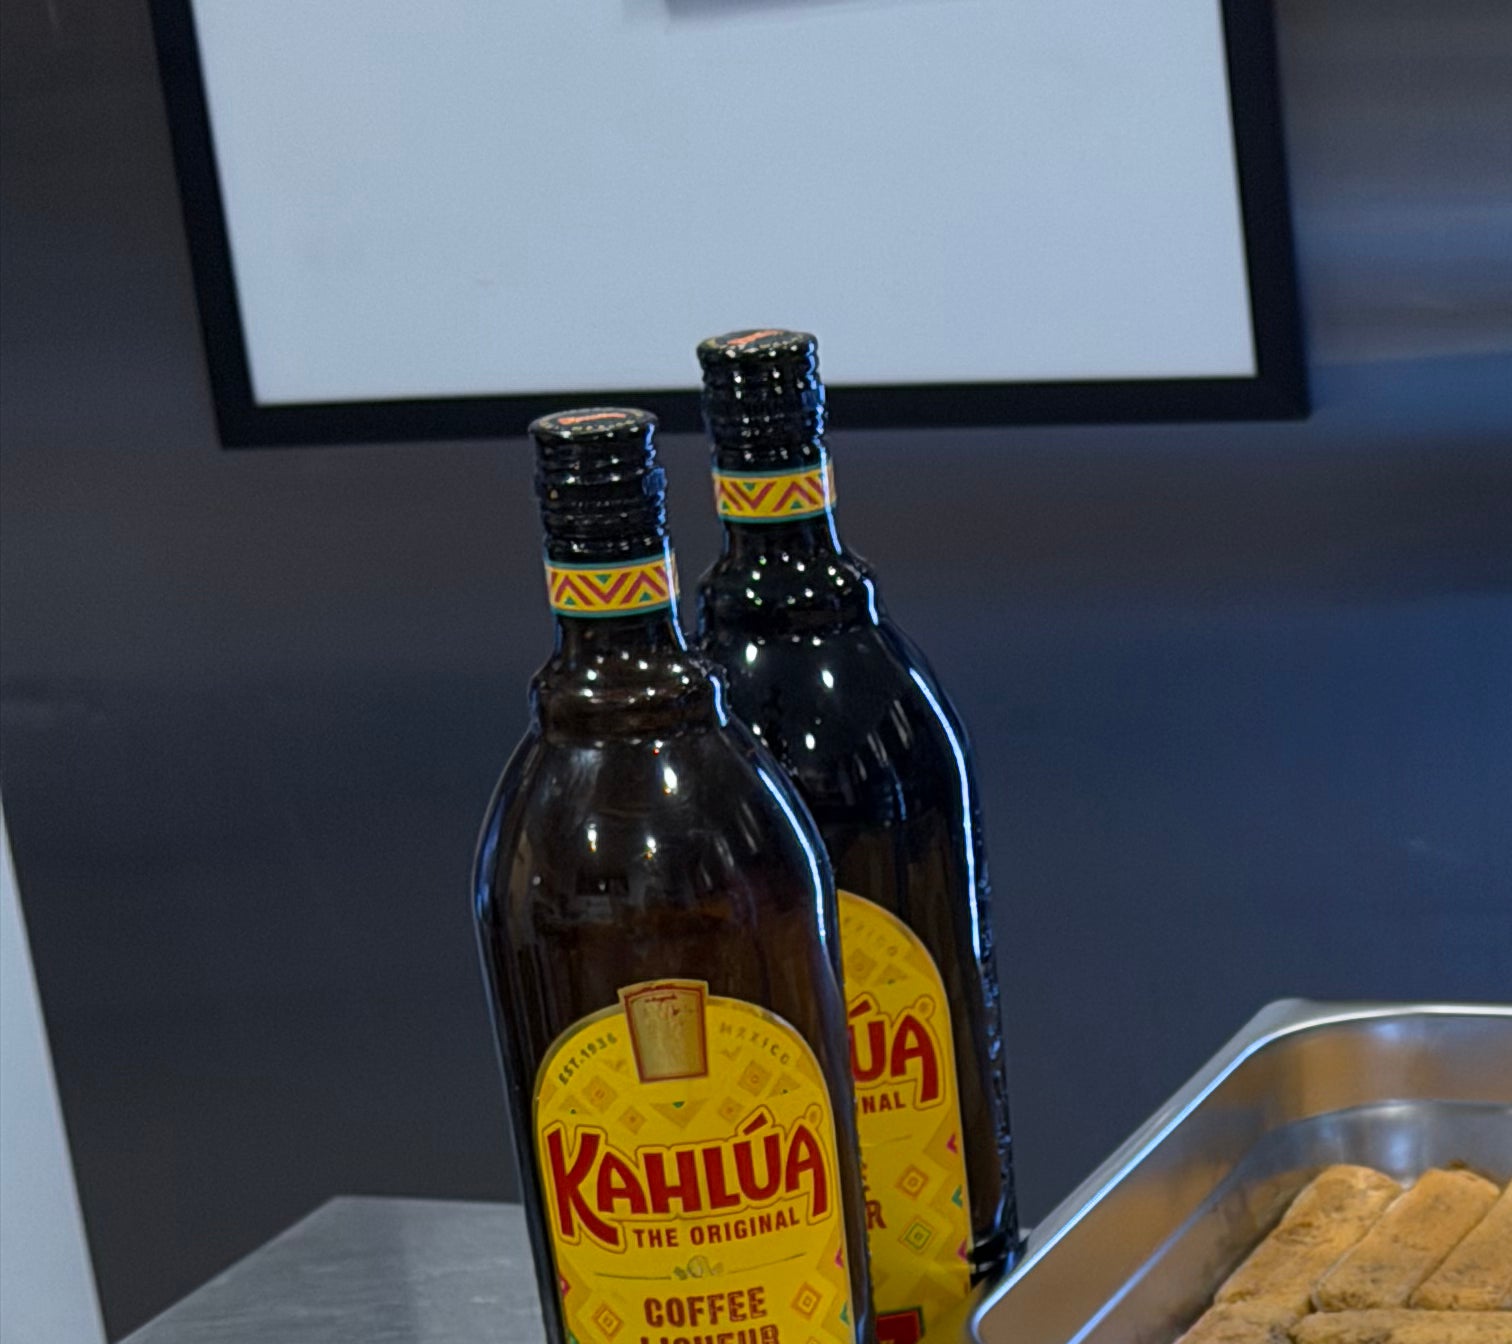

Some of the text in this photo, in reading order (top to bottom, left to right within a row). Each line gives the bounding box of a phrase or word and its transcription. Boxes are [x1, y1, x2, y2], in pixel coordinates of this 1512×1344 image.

[546, 1111, 829, 1247] KAHLÚA
[632, 1206, 801, 1249] THE ORIGINAL
[643, 1286, 768, 1328] COFFEE
